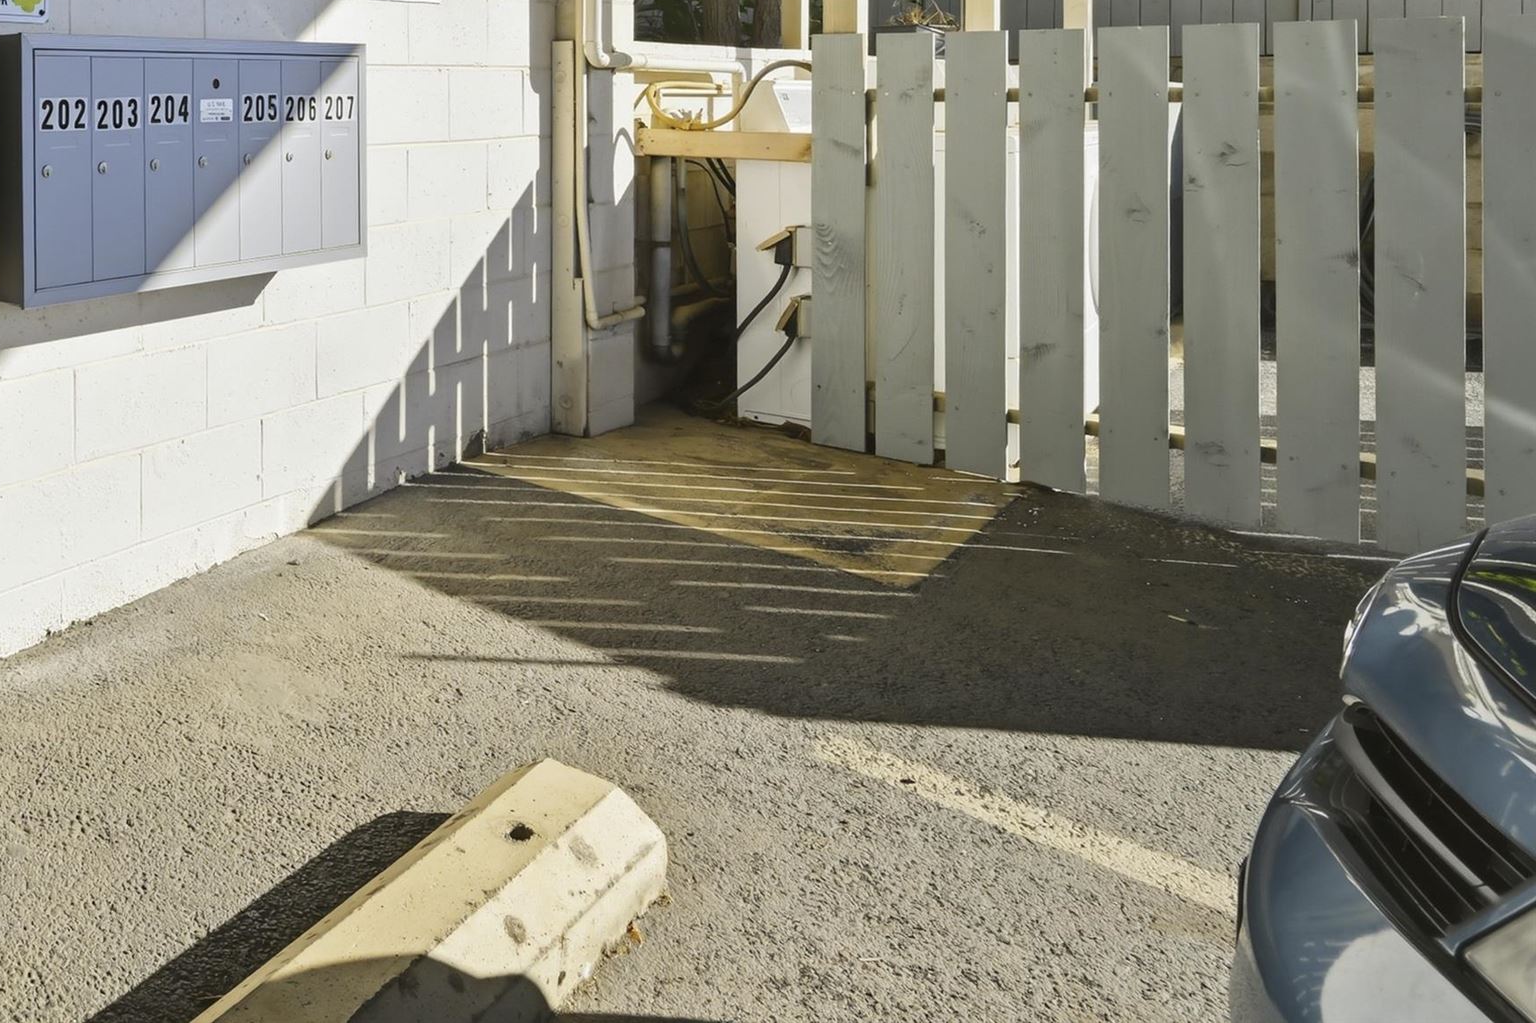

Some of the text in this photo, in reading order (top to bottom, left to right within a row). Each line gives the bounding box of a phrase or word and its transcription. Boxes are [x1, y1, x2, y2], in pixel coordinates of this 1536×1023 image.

[41, 99, 86, 130] 202
[97, 98, 138, 129] 203
[150, 95, 189, 124] 204
[244, 94, 277, 122] 205
[285, 96, 316, 122] 206
[325, 96, 354, 120] 207
